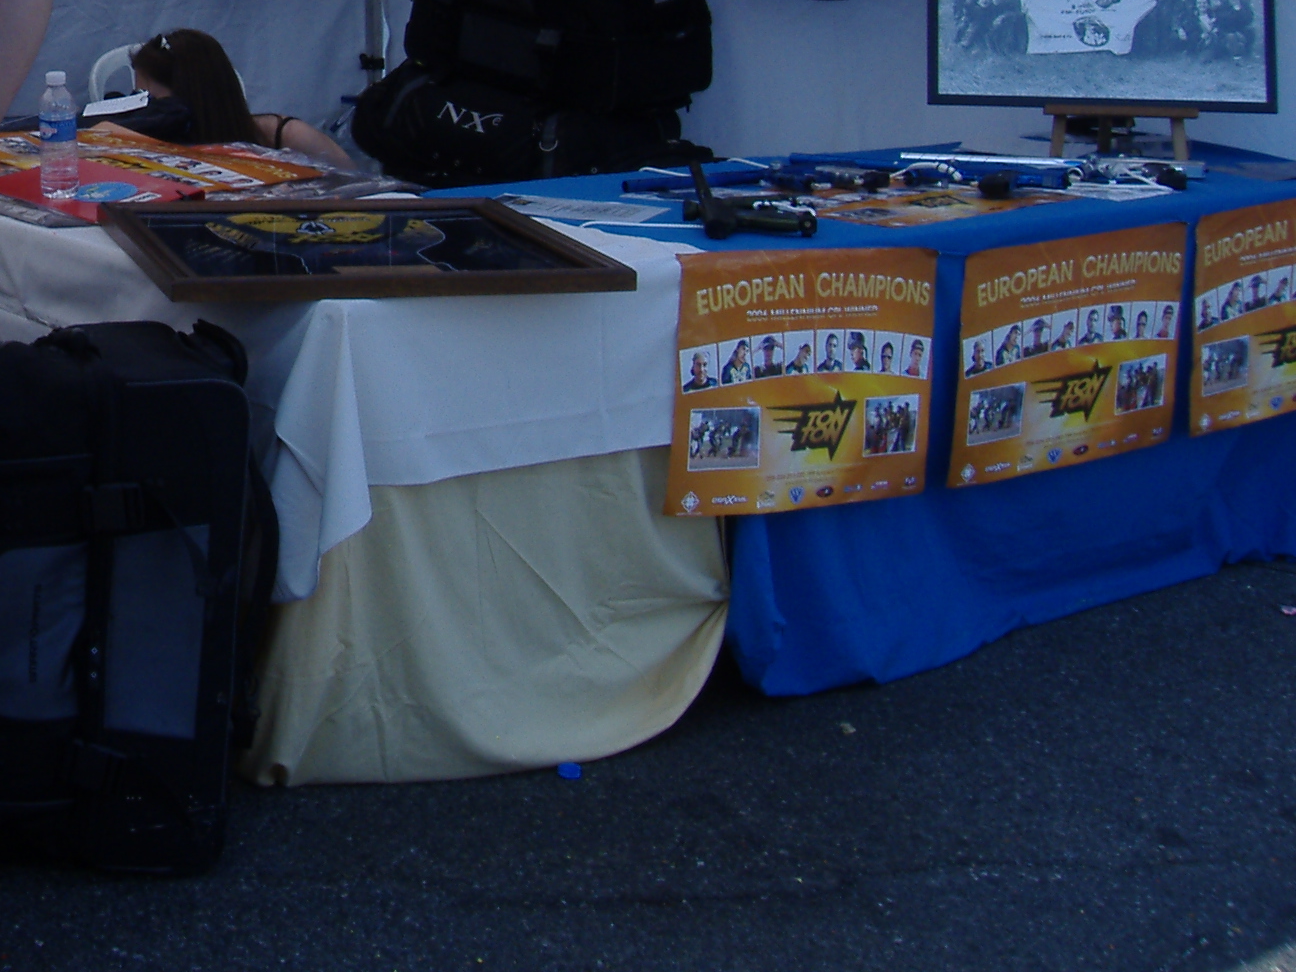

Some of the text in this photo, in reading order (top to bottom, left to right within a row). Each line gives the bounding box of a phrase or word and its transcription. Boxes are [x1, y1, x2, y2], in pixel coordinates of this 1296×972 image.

[1204, 220, 1288, 267] EUROPEAN
[696, 271, 932, 316] EUROPEAN CHAMPIONS
[977, 251, 1183, 307] EUROPEAN CHAMPIONS
